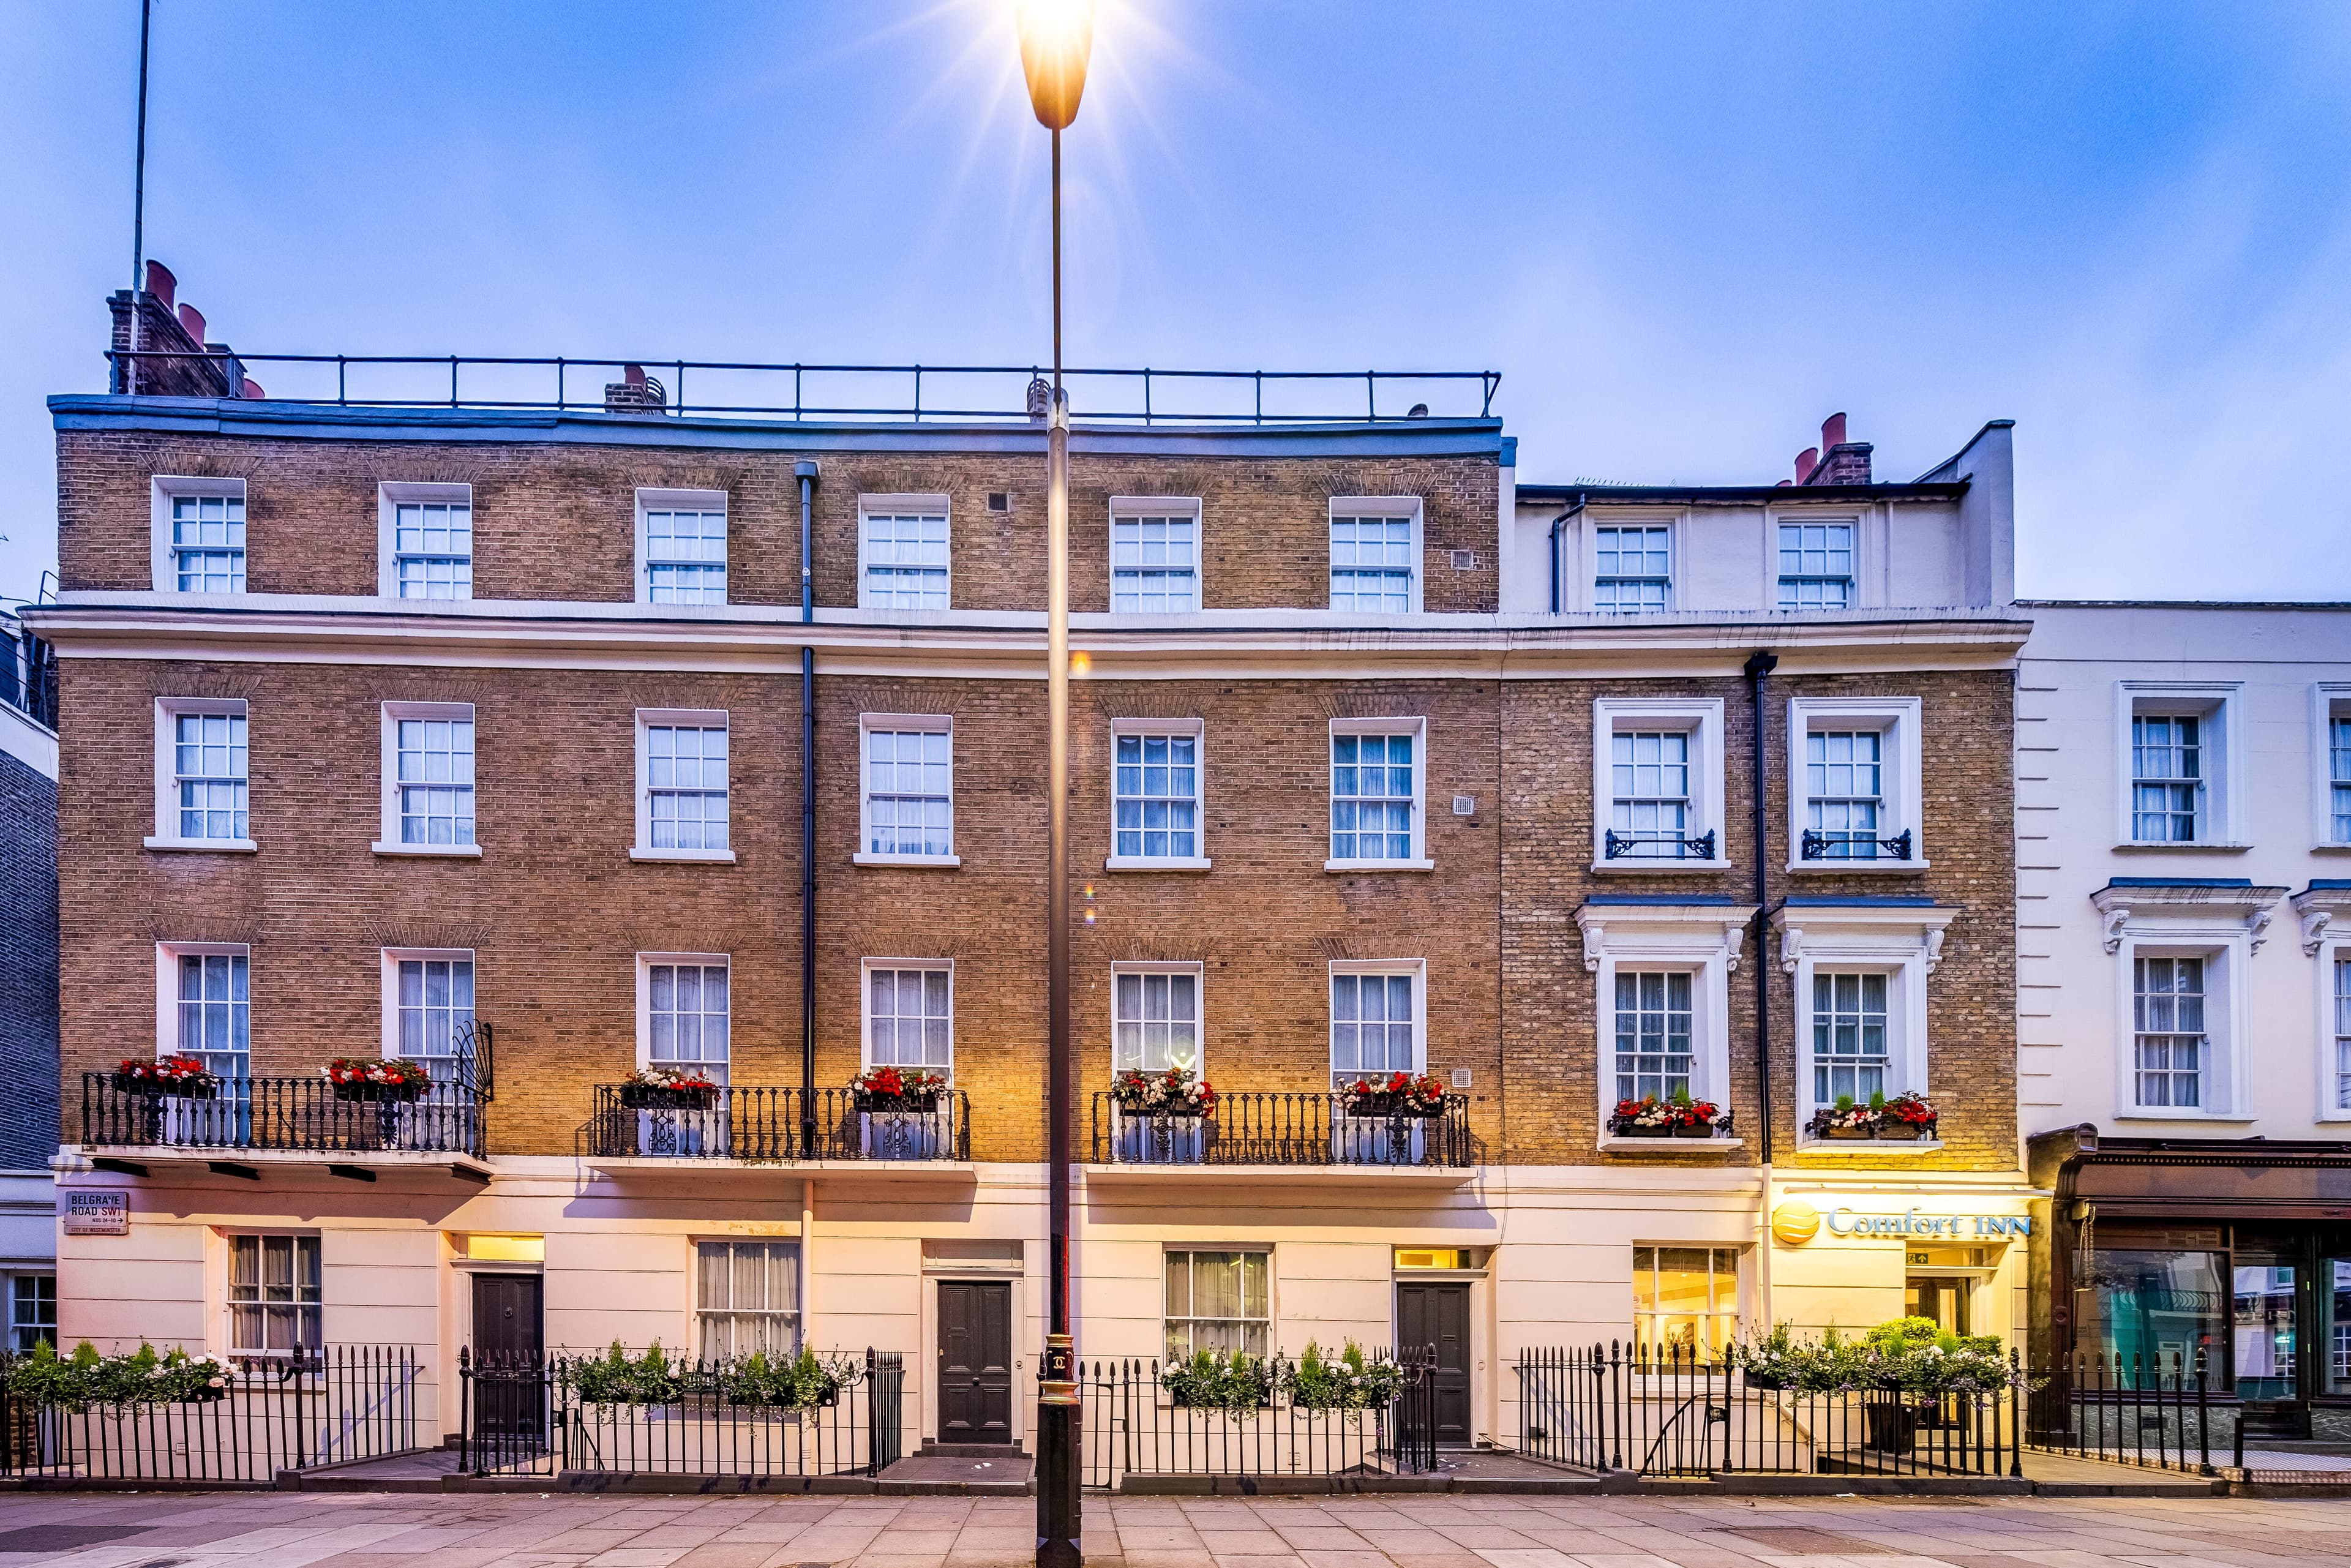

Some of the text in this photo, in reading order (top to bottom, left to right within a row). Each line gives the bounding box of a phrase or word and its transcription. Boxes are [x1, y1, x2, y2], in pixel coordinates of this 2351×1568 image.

[72, 1196, 120, 1205] BELGRAVE
[72, 1207, 121, 1216] ROAD SW1
[1828, 1207, 2031, 1235] Comfort INN
